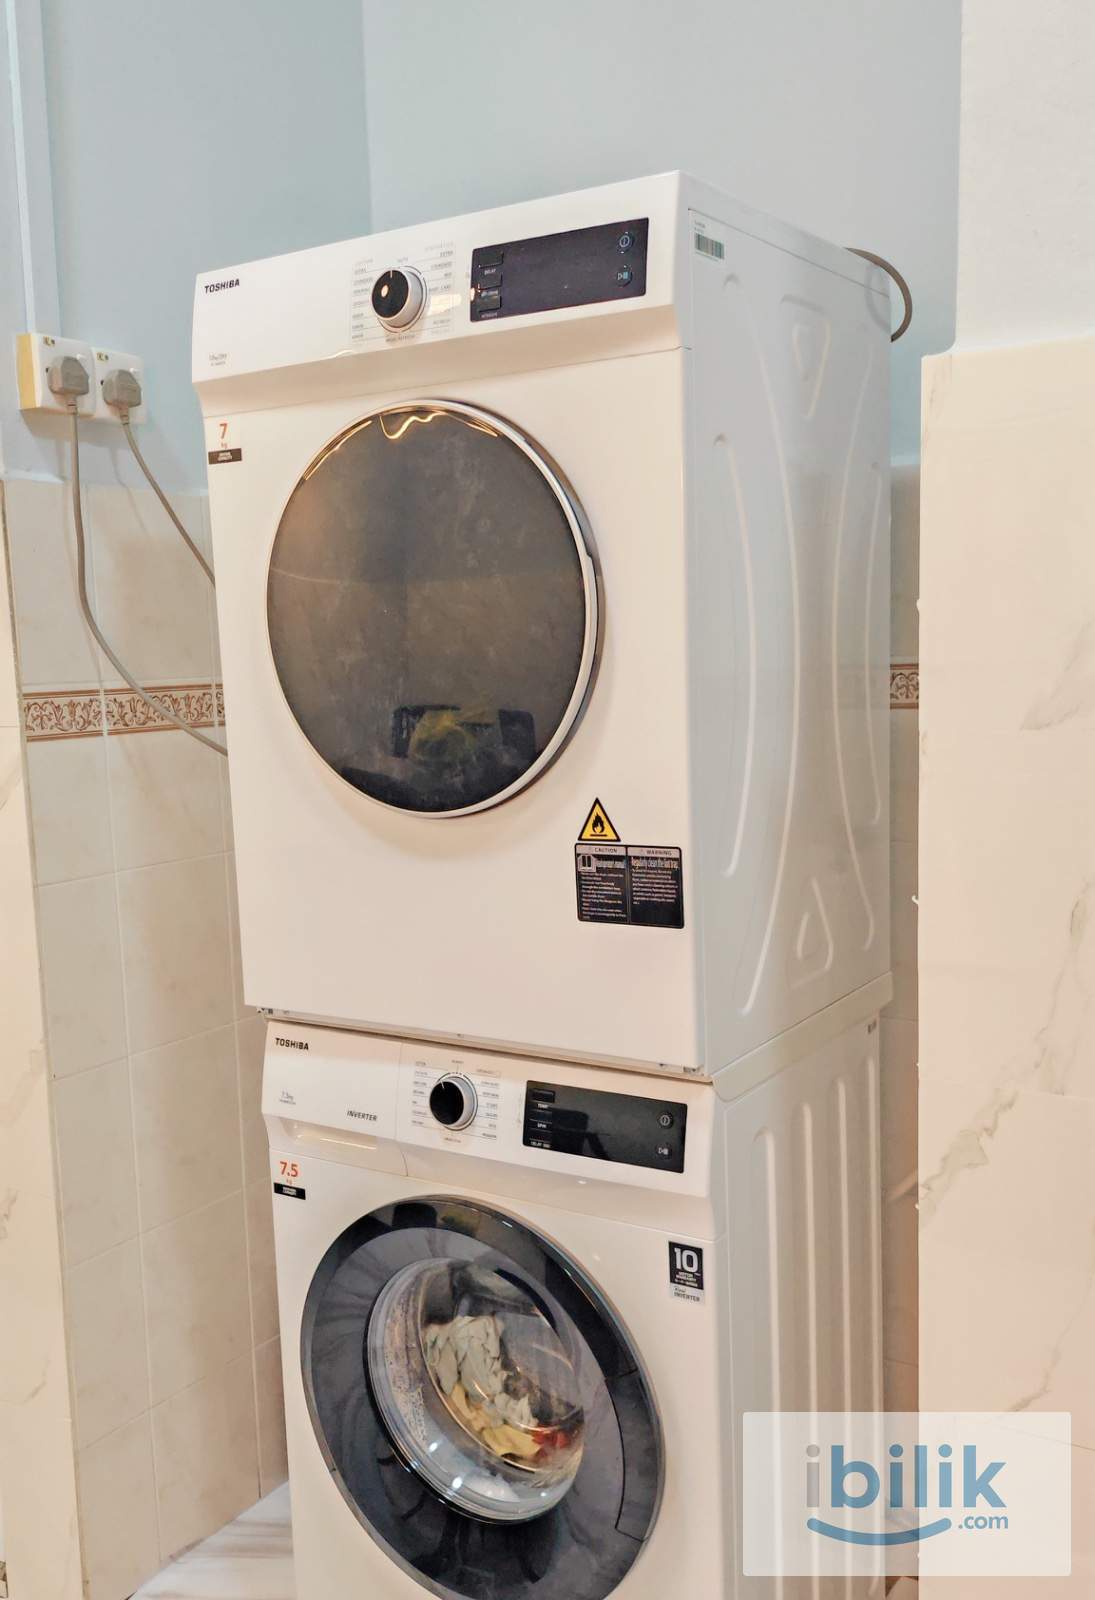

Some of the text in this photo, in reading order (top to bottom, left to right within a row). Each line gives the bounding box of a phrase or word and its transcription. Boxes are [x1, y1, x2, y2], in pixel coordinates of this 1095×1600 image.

[204, 278, 240, 294] TOSHIBA
[219, 422, 228, 440] 7
[275, 1037, 309, 1051] TOSHIBA
[346, 1110, 378, 1122] INVERTER
[279, 1160, 299, 1178] 7.5
[674, 1247, 699, 1273] 10
